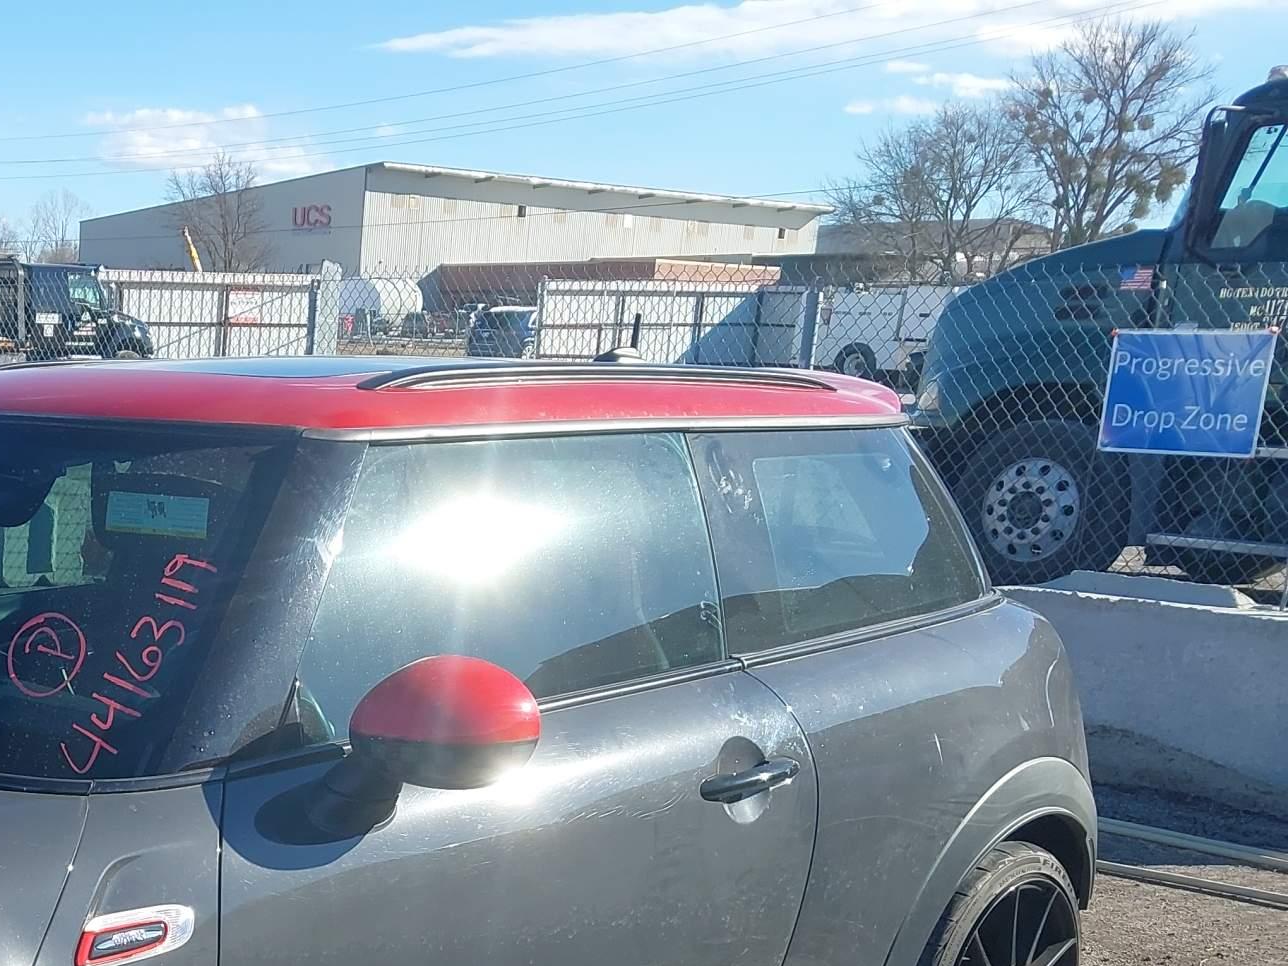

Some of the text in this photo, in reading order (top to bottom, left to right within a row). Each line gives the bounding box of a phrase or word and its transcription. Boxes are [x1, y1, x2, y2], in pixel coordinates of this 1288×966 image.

[292, 205, 332, 229] UCS
[1114, 352, 1265, 380] Progressive
[1113, 405, 1248, 432] Drop Zone
[60, 554, 218, 774] 44163119
